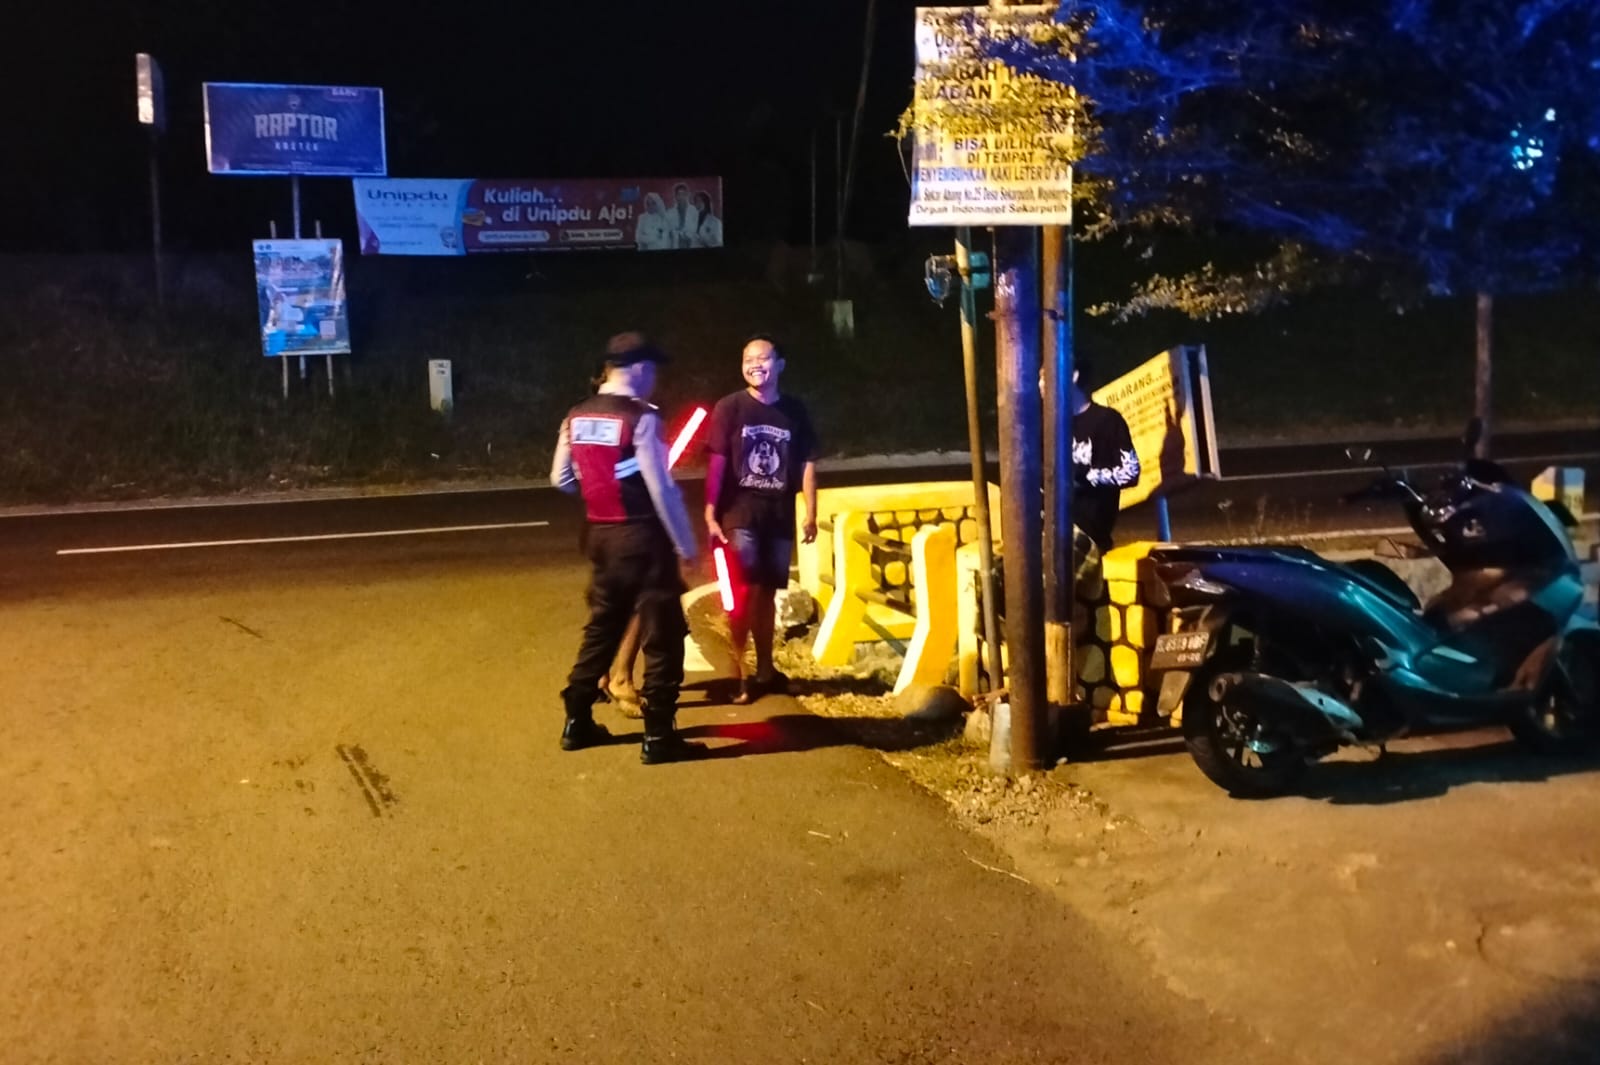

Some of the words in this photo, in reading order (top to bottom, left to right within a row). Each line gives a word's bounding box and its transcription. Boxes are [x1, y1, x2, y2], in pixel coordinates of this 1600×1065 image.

[254, 112, 338, 141] RAPTOR
[954, 137, 988, 150] BISA
[967, 152, 980, 164] DI
[985, 151, 1036, 164] TEMPAT
[367, 189, 448, 202] Unipdu
[502, 205, 520, 222] di
[527, 205, 591, 226] Unipdu
